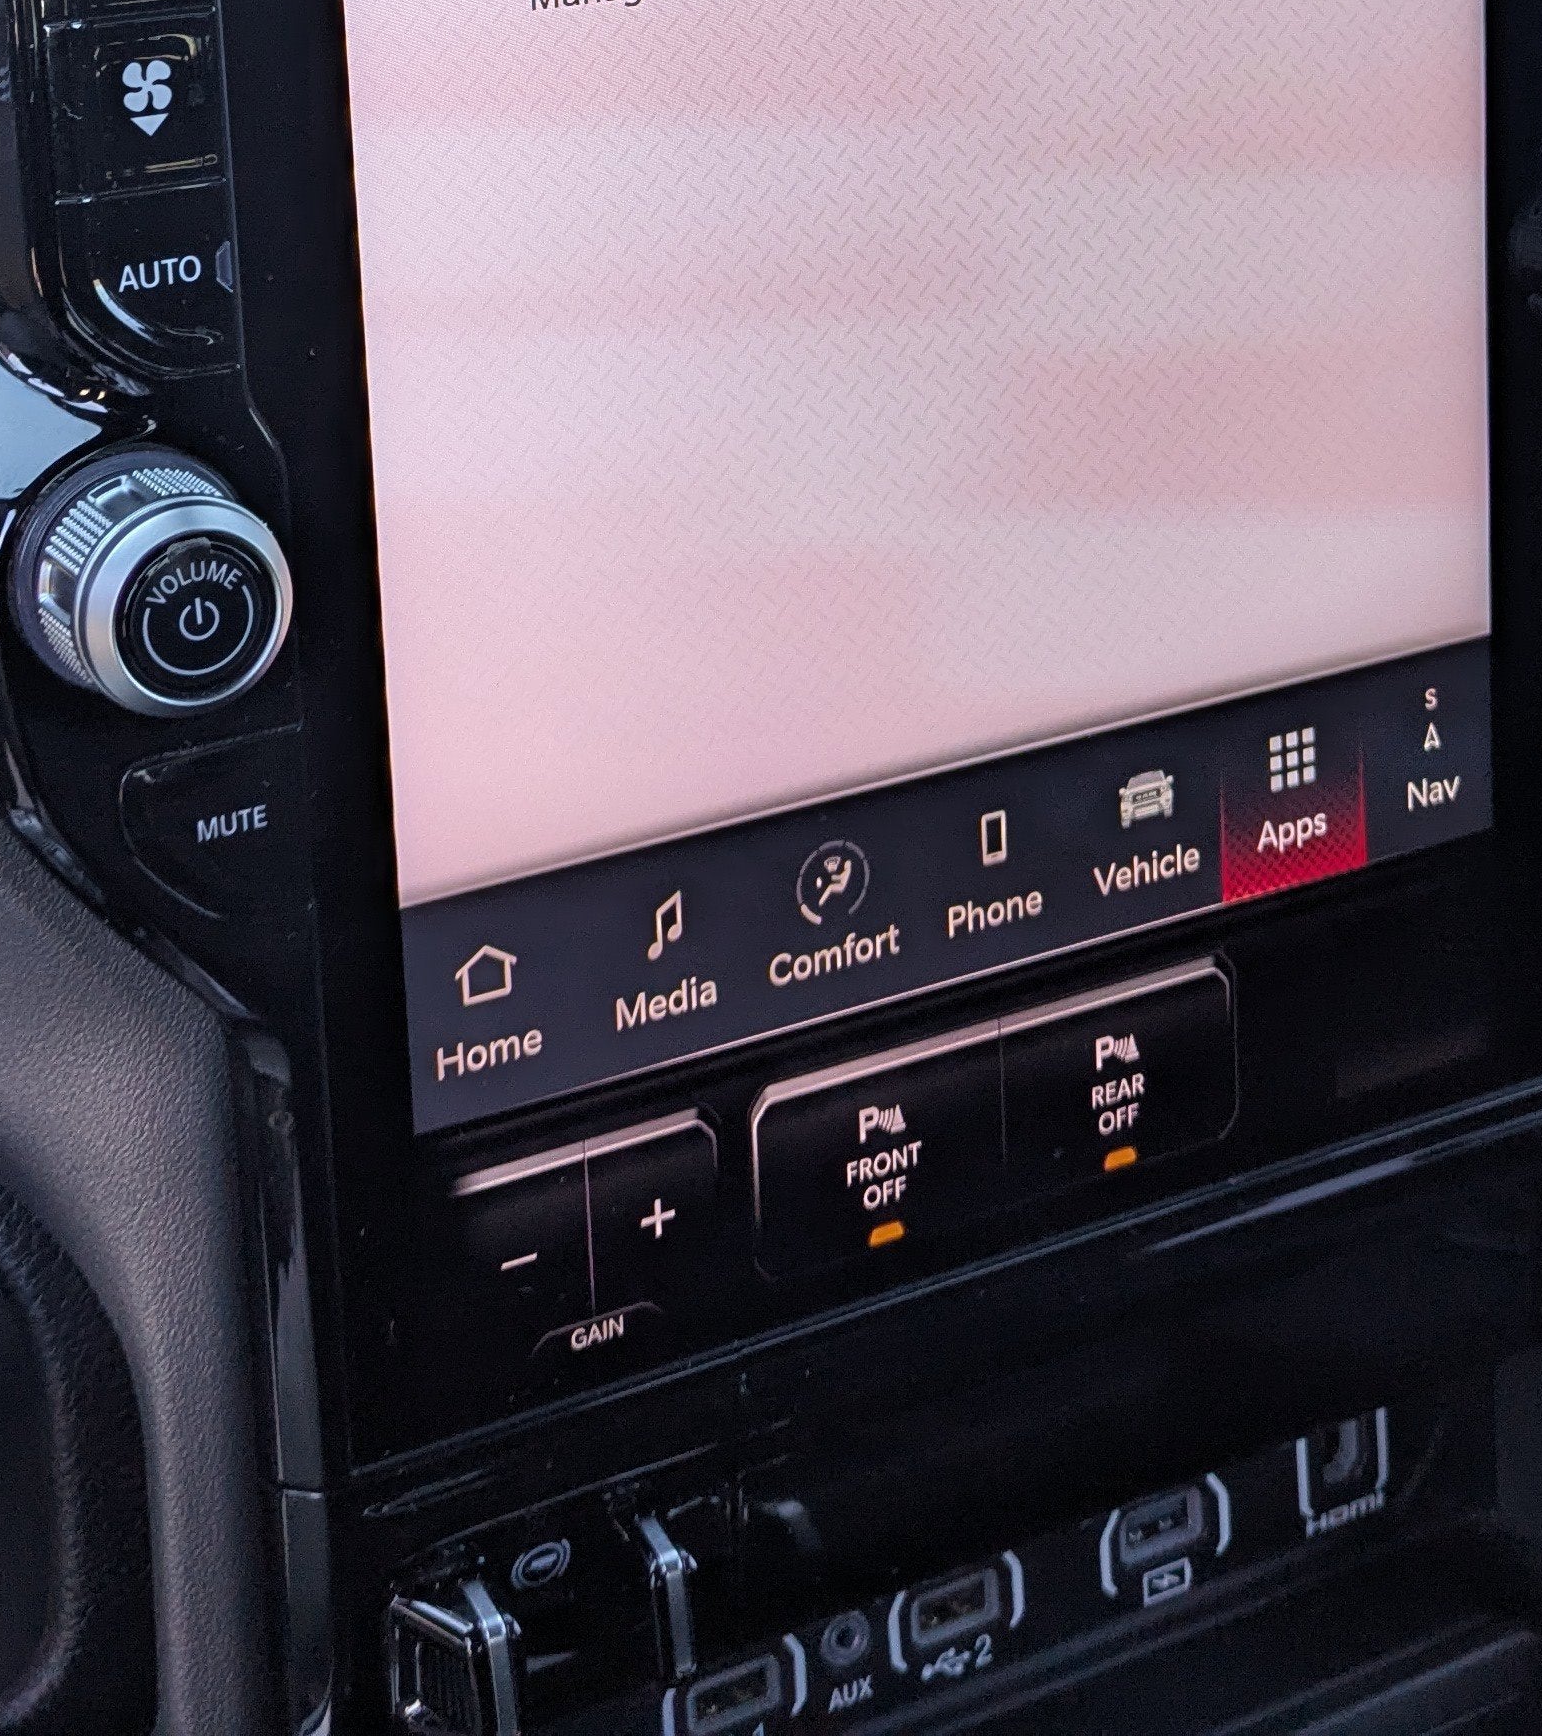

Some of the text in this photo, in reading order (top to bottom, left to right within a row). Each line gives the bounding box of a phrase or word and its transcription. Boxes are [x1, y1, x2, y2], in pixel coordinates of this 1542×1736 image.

[117, 254, 202, 294] AUTO
[145, 560, 244, 608] VOLUME
[1424, 688, 1438, 711] S
[1406, 775, 1460, 812] Nav
[196, 803, 269, 844] MUTE
[1256, 811, 1328, 856] Apps
[1093, 843, 1201, 896] Vehicle
[947, 889, 1044, 939] Phone
[768, 923, 901, 987] Comfort
[614, 975, 719, 1033] Media
[434, 1027, 544, 1082] Home
[1090, 1072, 1146, 1111] REAR
[1097, 1102, 1140, 1138] OFF
[845, 1140, 923, 1188] FRONT
[862, 1174, 908, 1212] OFF
[569, 1313, 626, 1353] GAIN
[827, 1674, 875, 1714] AUX
